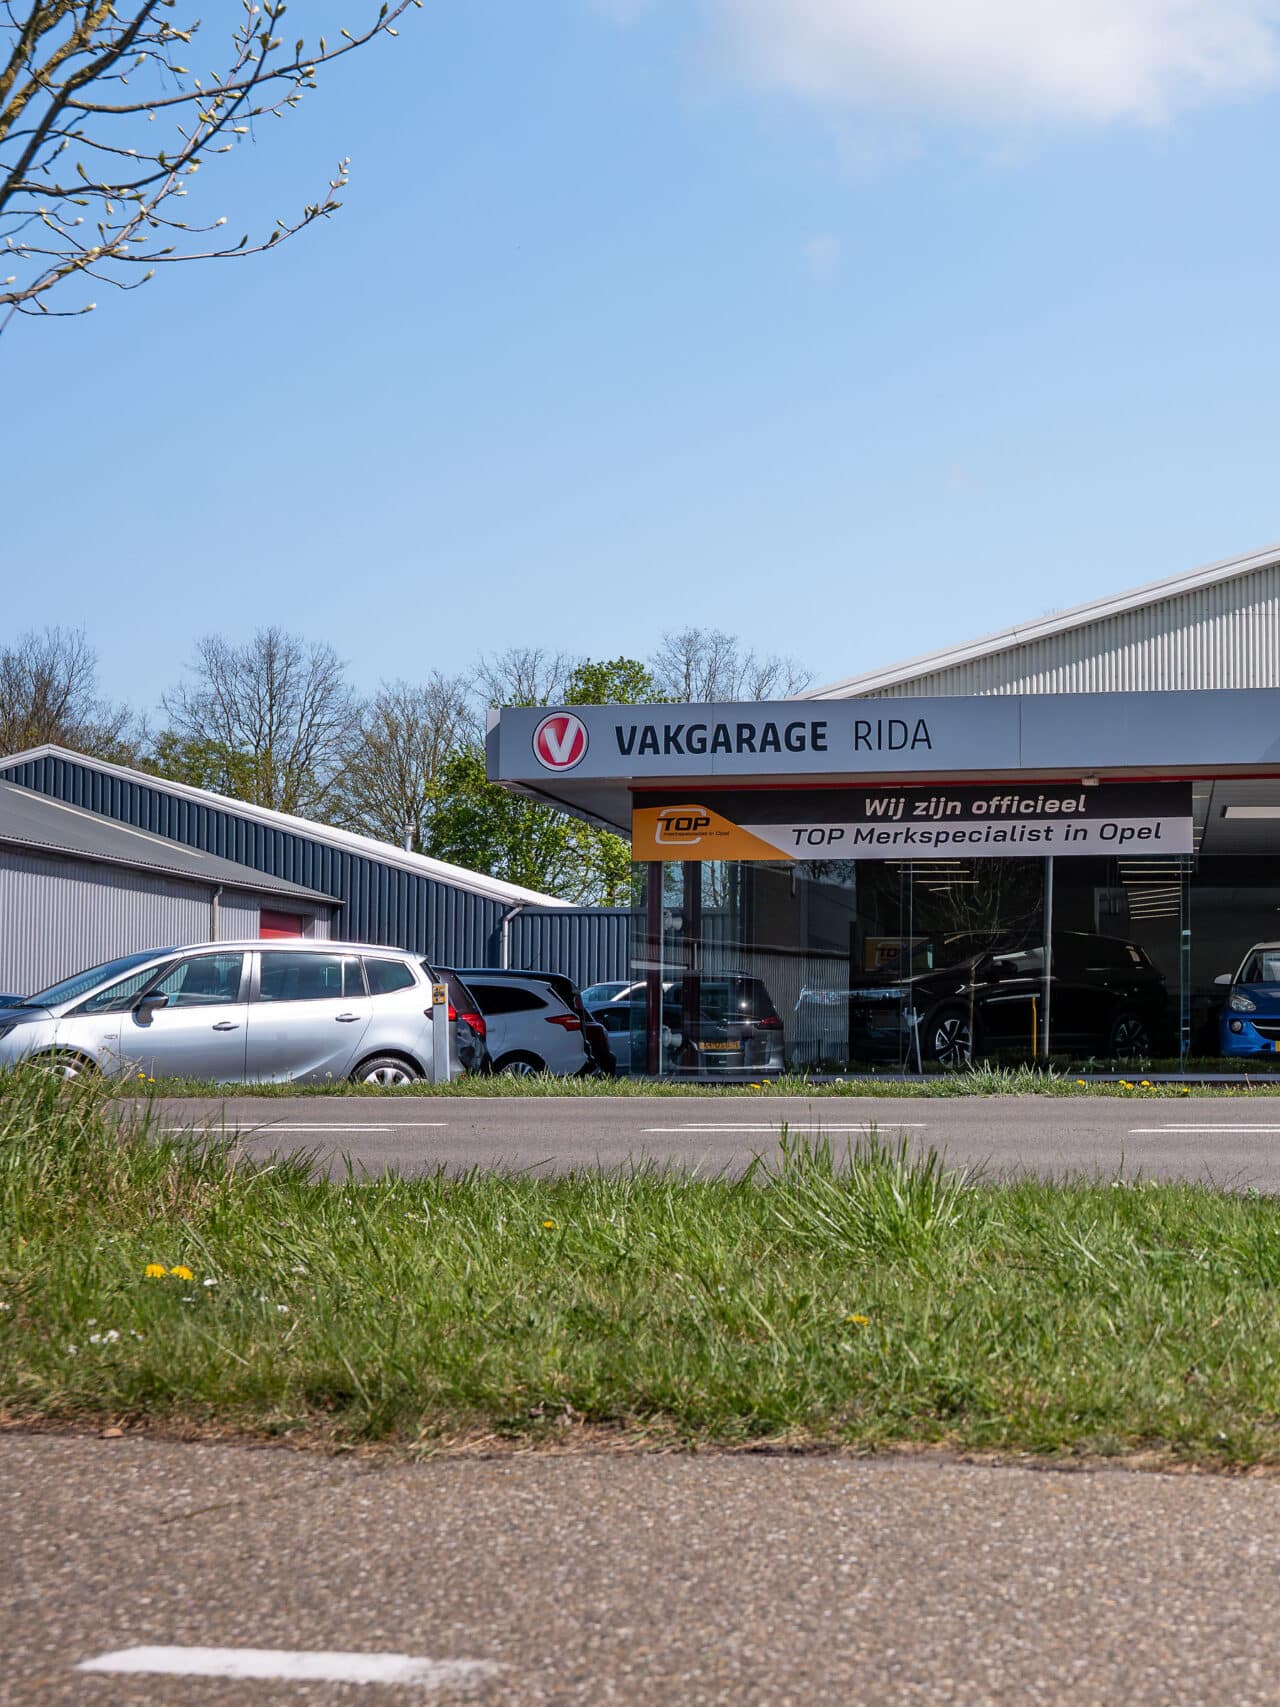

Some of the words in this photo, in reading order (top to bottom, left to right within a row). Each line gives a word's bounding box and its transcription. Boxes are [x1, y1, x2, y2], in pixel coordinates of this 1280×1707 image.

[544, 718, 580, 763] V
[615, 722, 828, 756] VAKGARAGE
[854, 719, 933, 751] RIDA
[865, 798, 905, 820] Wij
[912, 797, 962, 819] zijn
[971, 795, 1086, 814] officieel
[657, 817, 710, 831] TOP
[792, 828, 845, 846] TOP
[853, 824, 1054, 848] Merkspecialist
[1064, 824, 1088, 841] in
[1099, 822, 1161, 845] Opel
